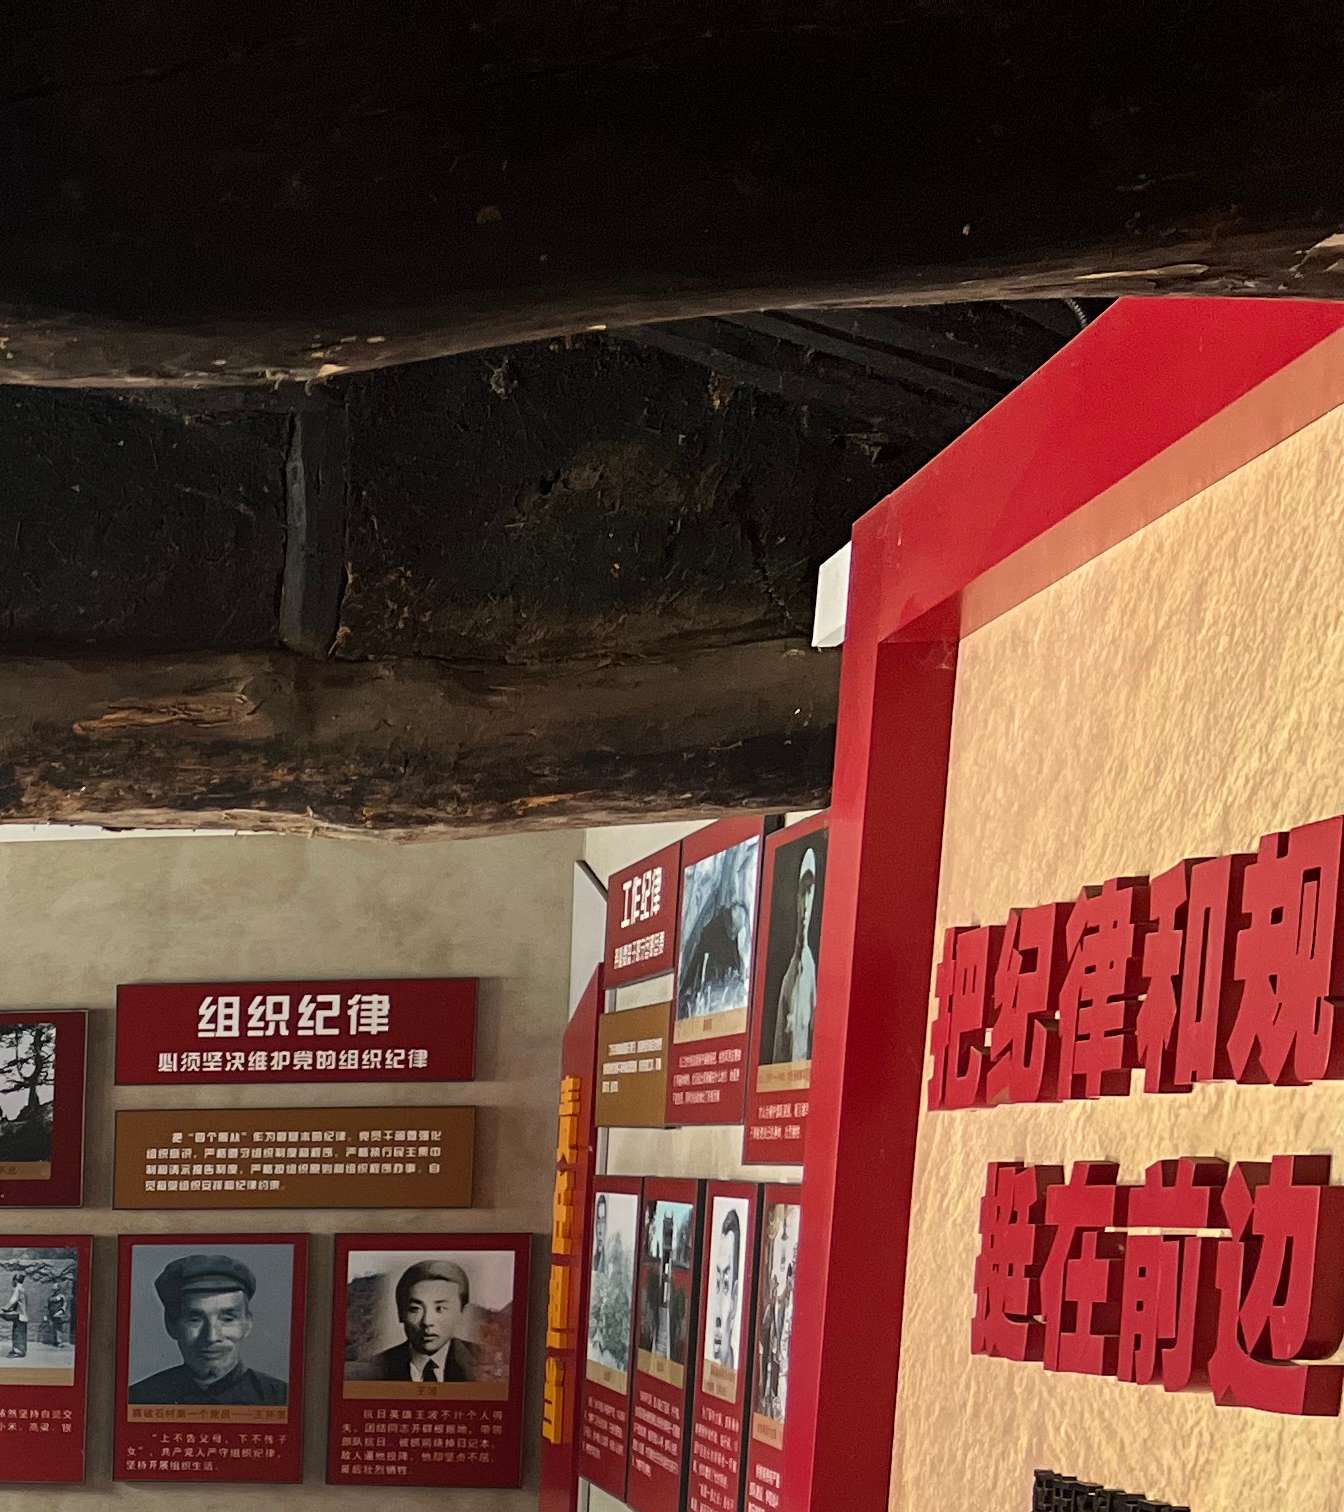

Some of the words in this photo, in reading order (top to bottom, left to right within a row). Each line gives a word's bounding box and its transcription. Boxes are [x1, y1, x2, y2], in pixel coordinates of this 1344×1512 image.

[197, 994, 391, 1038] 组织纪律
[928, 814, 1344, 1111] 把纪律和规
[157, 1047, 429, 1073] 必须坚决维护党的组织纪律
[970, 1154, 1344, 1418] 挺在前边
